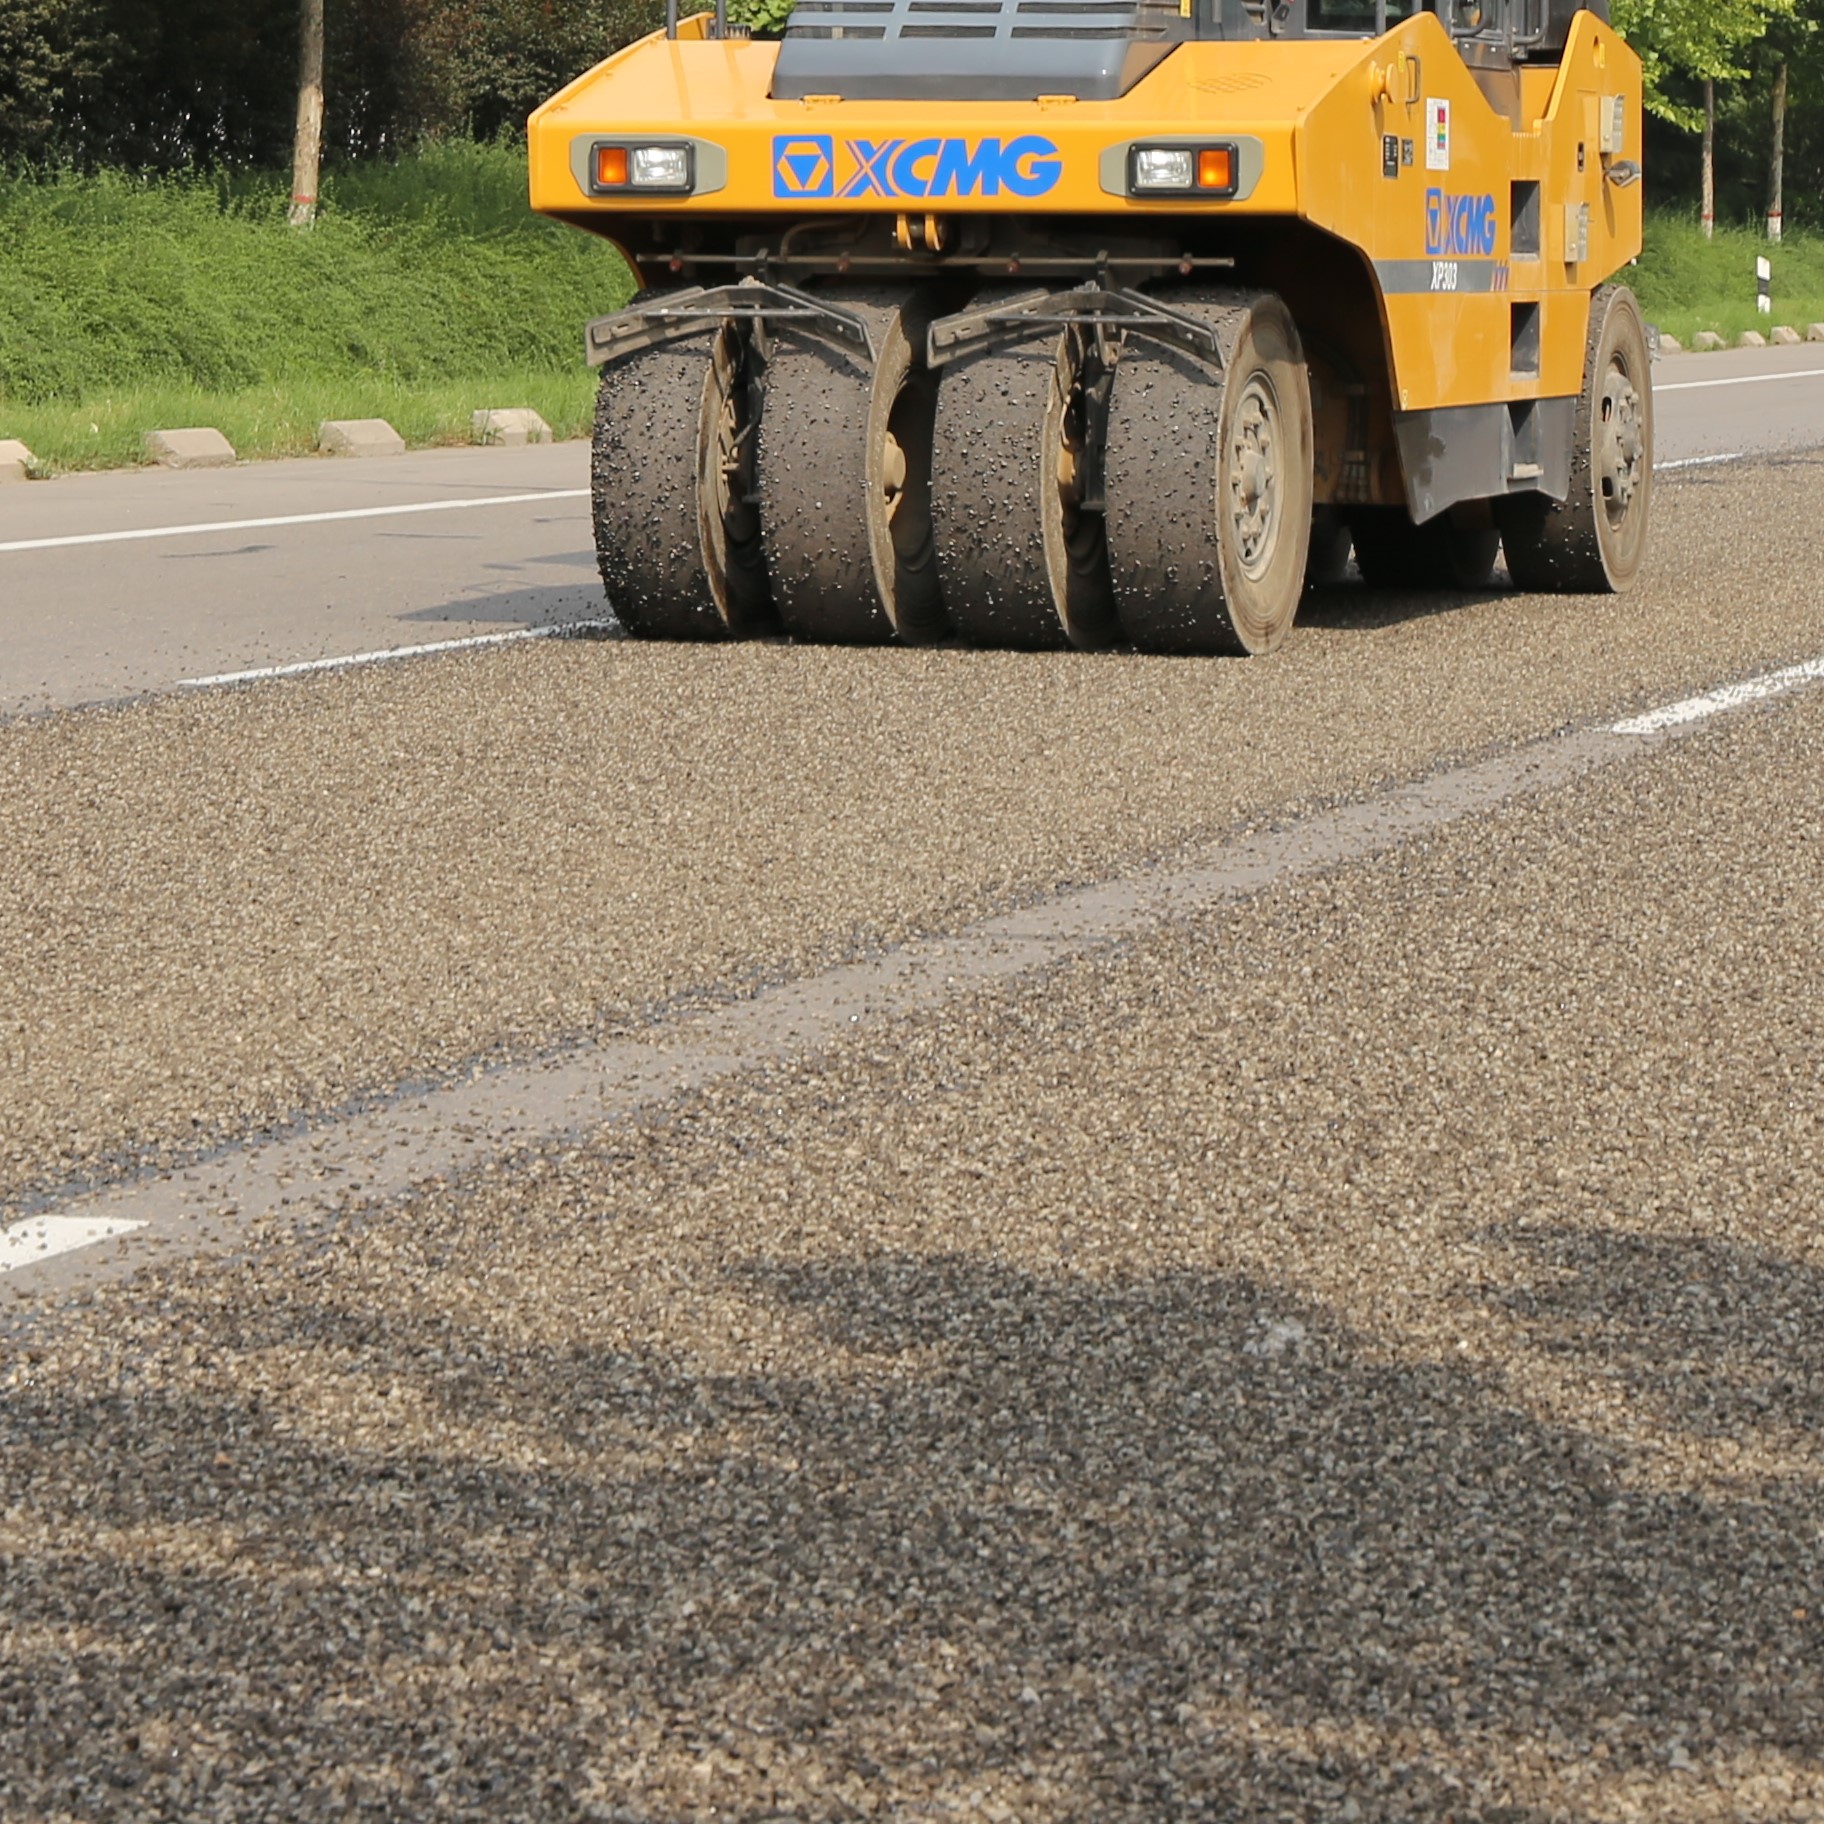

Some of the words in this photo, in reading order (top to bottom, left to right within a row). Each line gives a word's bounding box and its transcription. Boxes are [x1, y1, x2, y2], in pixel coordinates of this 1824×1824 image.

[835, 134, 1062, 197] XCMG
[1444, 193, 1496, 255] XCMG
[1431, 262, 1458, 290] XP303
